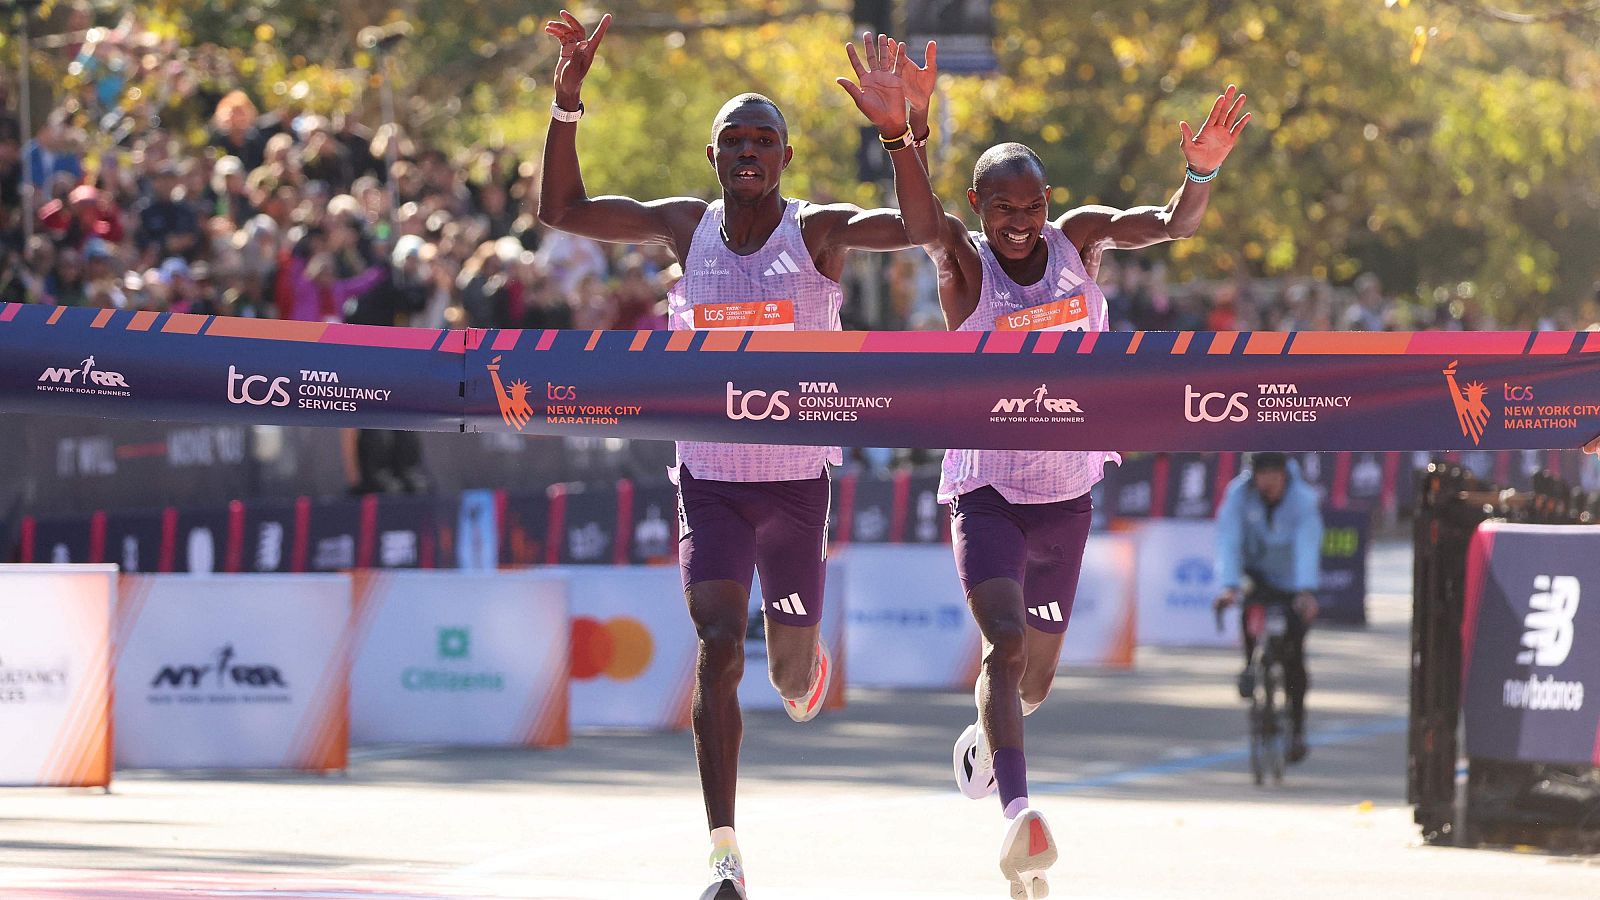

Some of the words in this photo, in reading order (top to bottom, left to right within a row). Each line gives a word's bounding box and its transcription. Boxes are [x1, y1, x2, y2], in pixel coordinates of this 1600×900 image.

[704, 307, 725, 321] tcs
[1069, 307, 1083, 315] TATA
[1008, 314, 1031, 329] tcs
[299, 370, 339, 383] TATA
[227, 365, 291, 407] tcs
[547, 382, 577, 401] tcs
[798, 382, 839, 394] TATA
[1257, 383, 1298, 395] TATA
[1504, 382, 1534, 401] tcs
[97, 389, 131, 397] RUNNERS
[298, 384, 392, 401] CONSULTANCY
[298, 398, 357, 412] SERVICES
[726, 381, 791, 421] tcs
[798, 396, 893, 409] CONSULTANCY
[1184, 384, 1249, 423] tcs
[1257, 396, 1352, 408] CONSULTANCY
[547, 405, 577, 415] NEW
[579, 406, 612, 415] YORK
[614, 406, 642, 416] CITY
[798, 410, 858, 422] SERVICES
[1257, 410, 1317, 422] SERVICES
[1504, 406, 1534, 416] NEW
[1536, 406, 1570, 416] YORK
[1572, 405, 1600, 415] CITY
[546, 416, 619, 425] MARATHON
[1504, 418, 1577, 429] MARATHON
